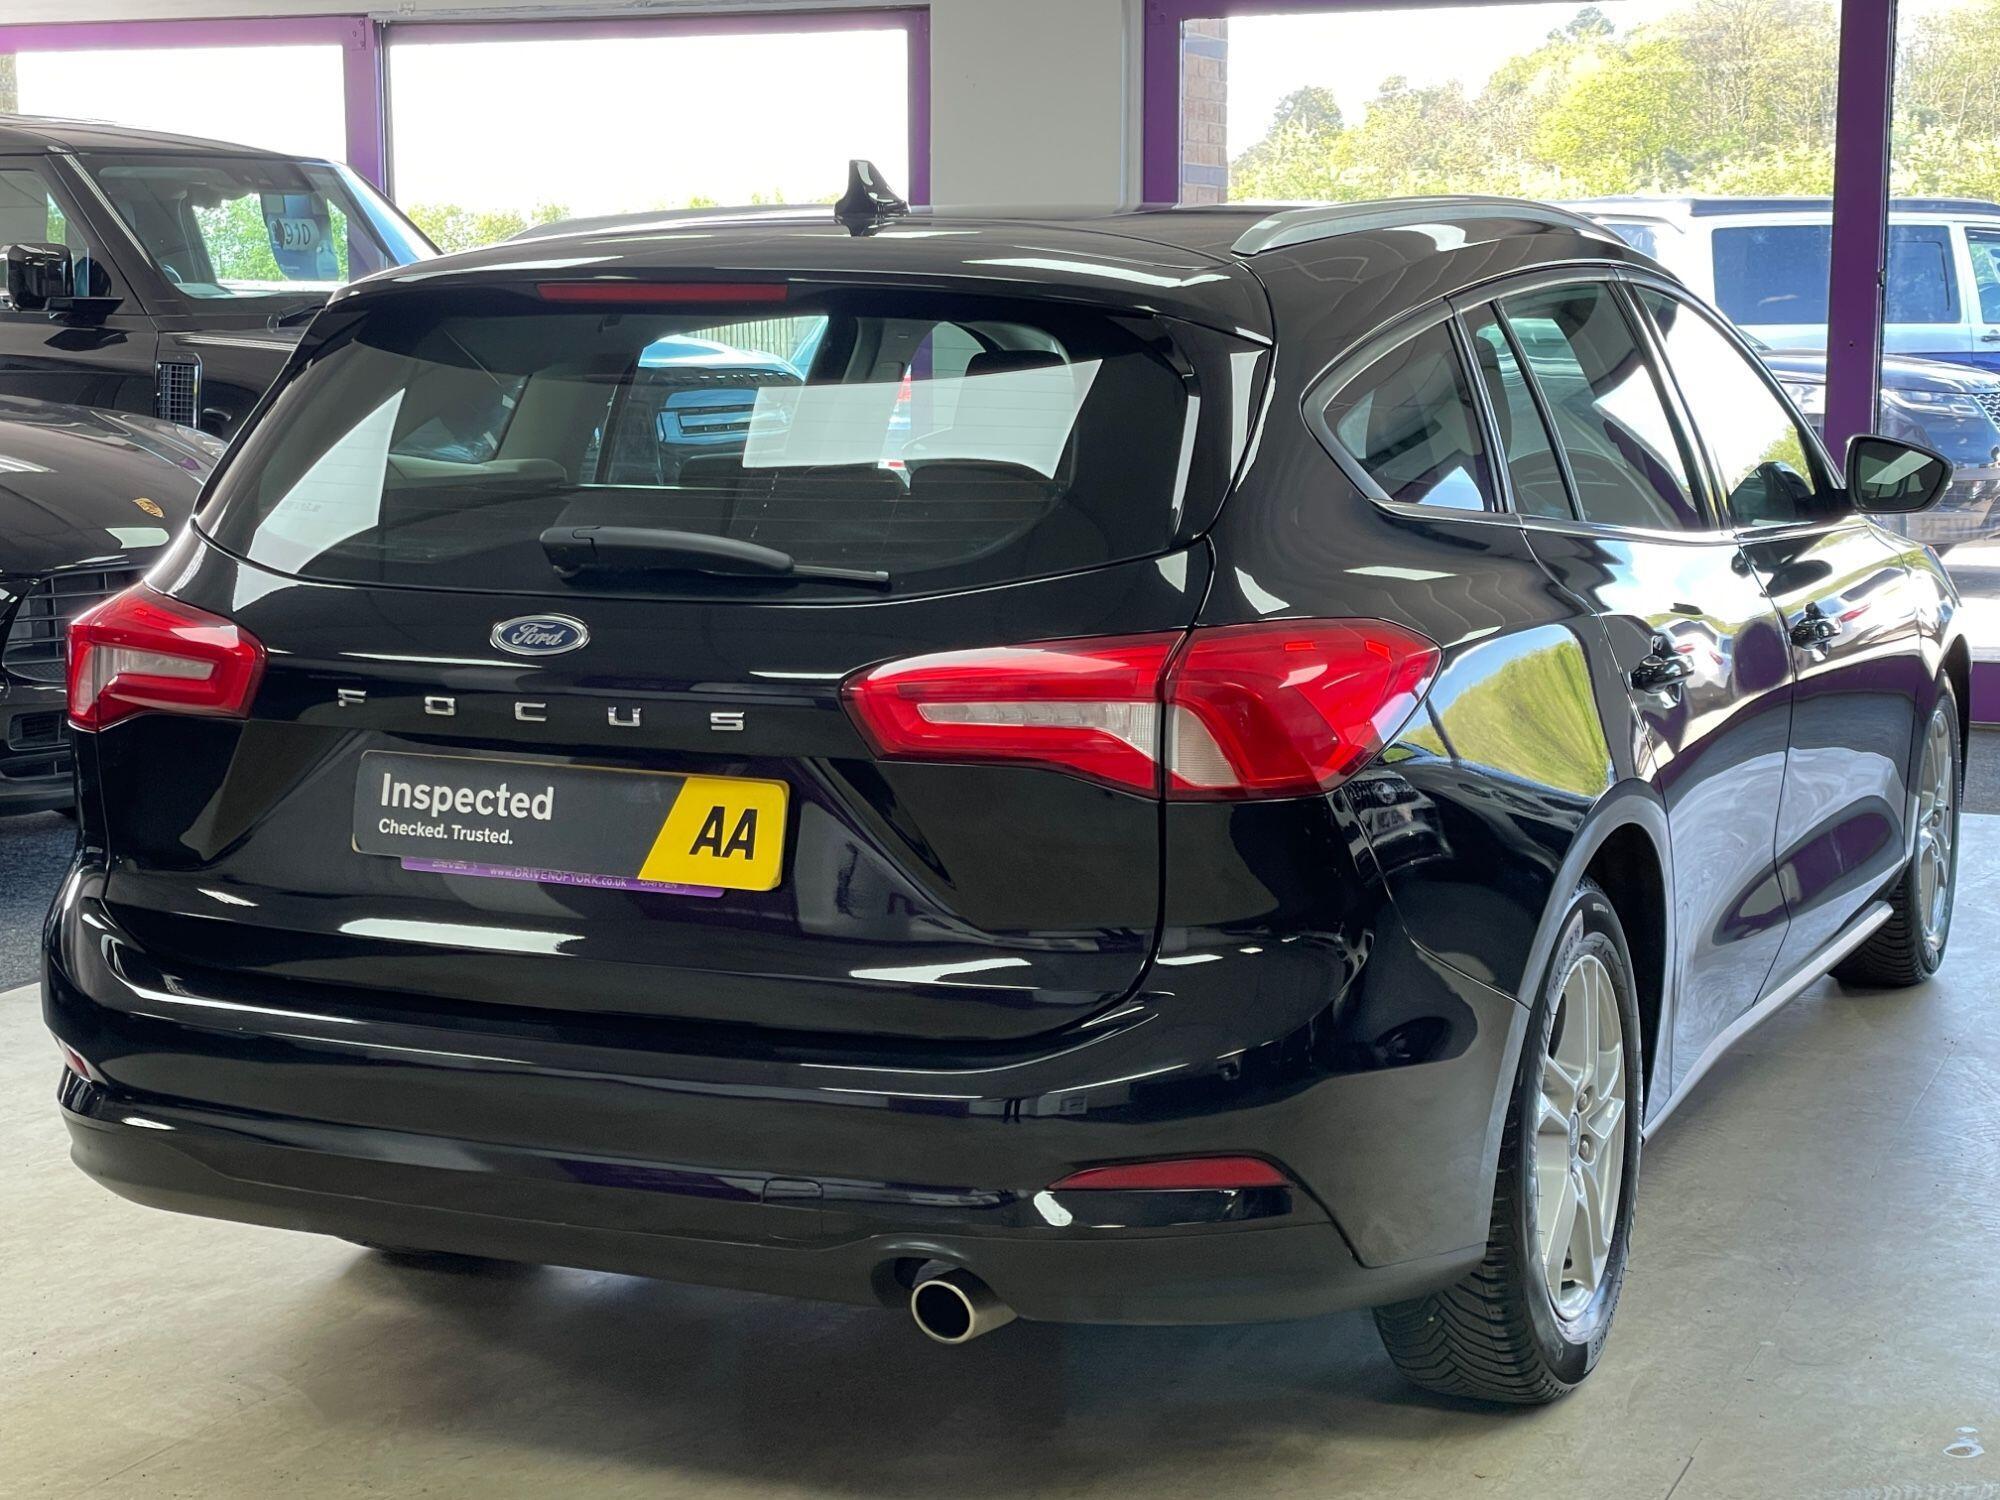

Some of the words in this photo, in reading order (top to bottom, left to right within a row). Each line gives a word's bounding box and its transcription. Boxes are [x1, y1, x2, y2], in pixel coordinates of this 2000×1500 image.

[511, 622, 566, 647] Ford
[338, 688, 744, 731] FOCUS
[381, 772, 554, 821] Inspected
[378, 818, 448, 840] Checked.
[451, 824, 513, 845] Trusted.
[688, 806, 758, 860] AA
[490, 867, 627, 888] www.DRIVENOFYORK.co.uk
